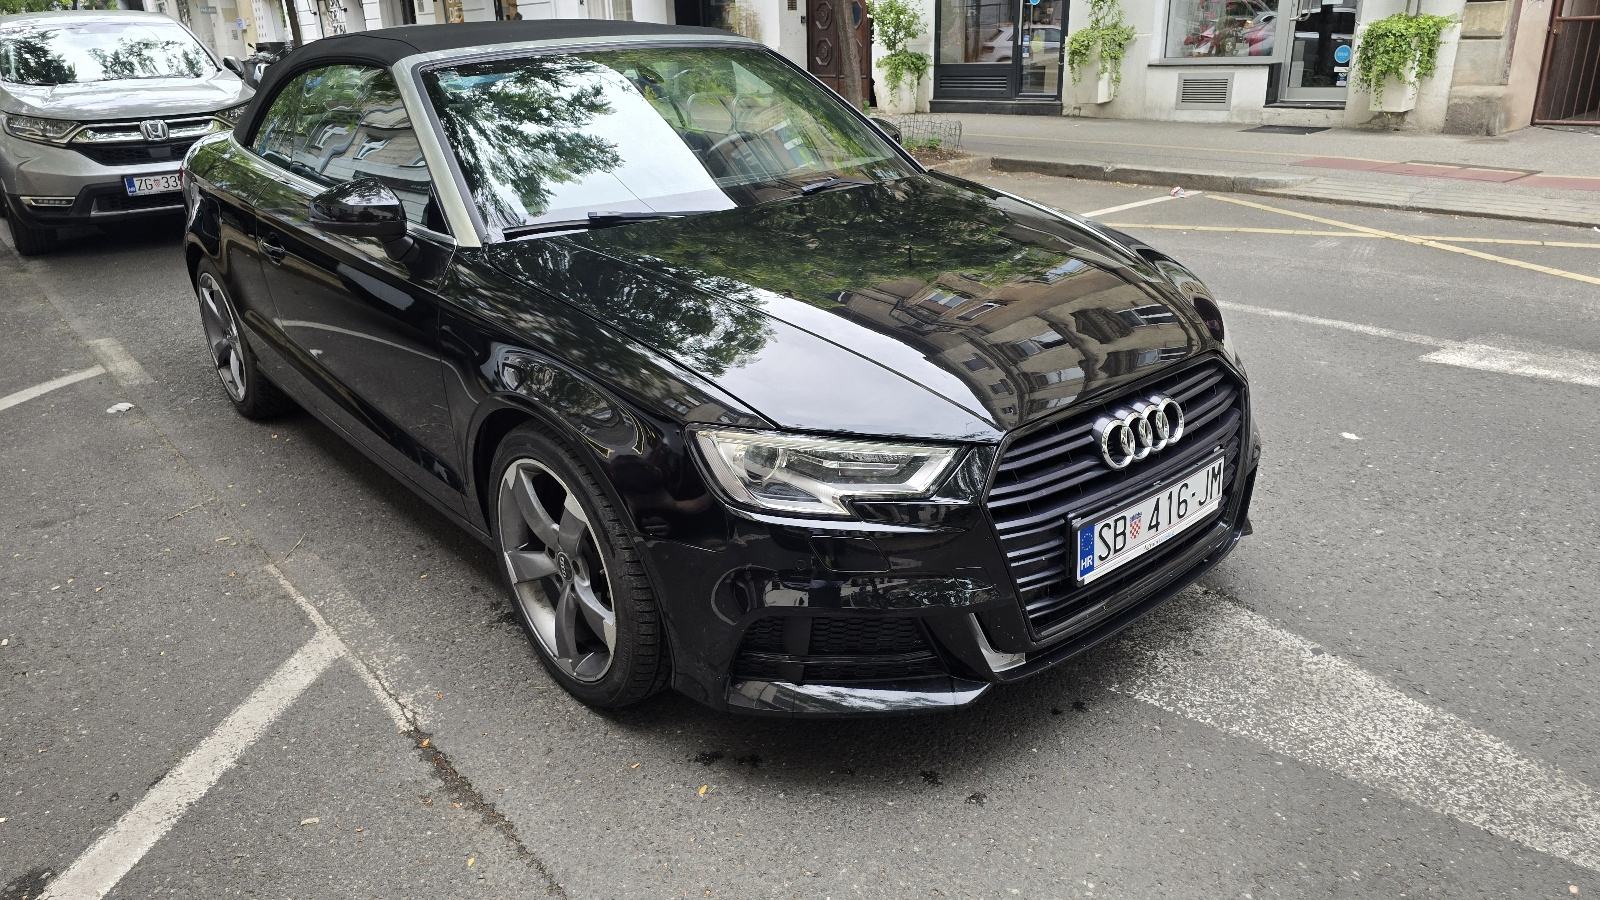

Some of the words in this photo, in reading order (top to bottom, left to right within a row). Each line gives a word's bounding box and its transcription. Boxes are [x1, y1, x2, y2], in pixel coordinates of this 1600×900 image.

[136, 178, 153, 191] ZG
[162, 176, 181, 188] 33
[1099, 515, 1127, 561] SB
[1147, 463, 1222, 532] 416-JM
[1080, 555, 1093, 571] HR
